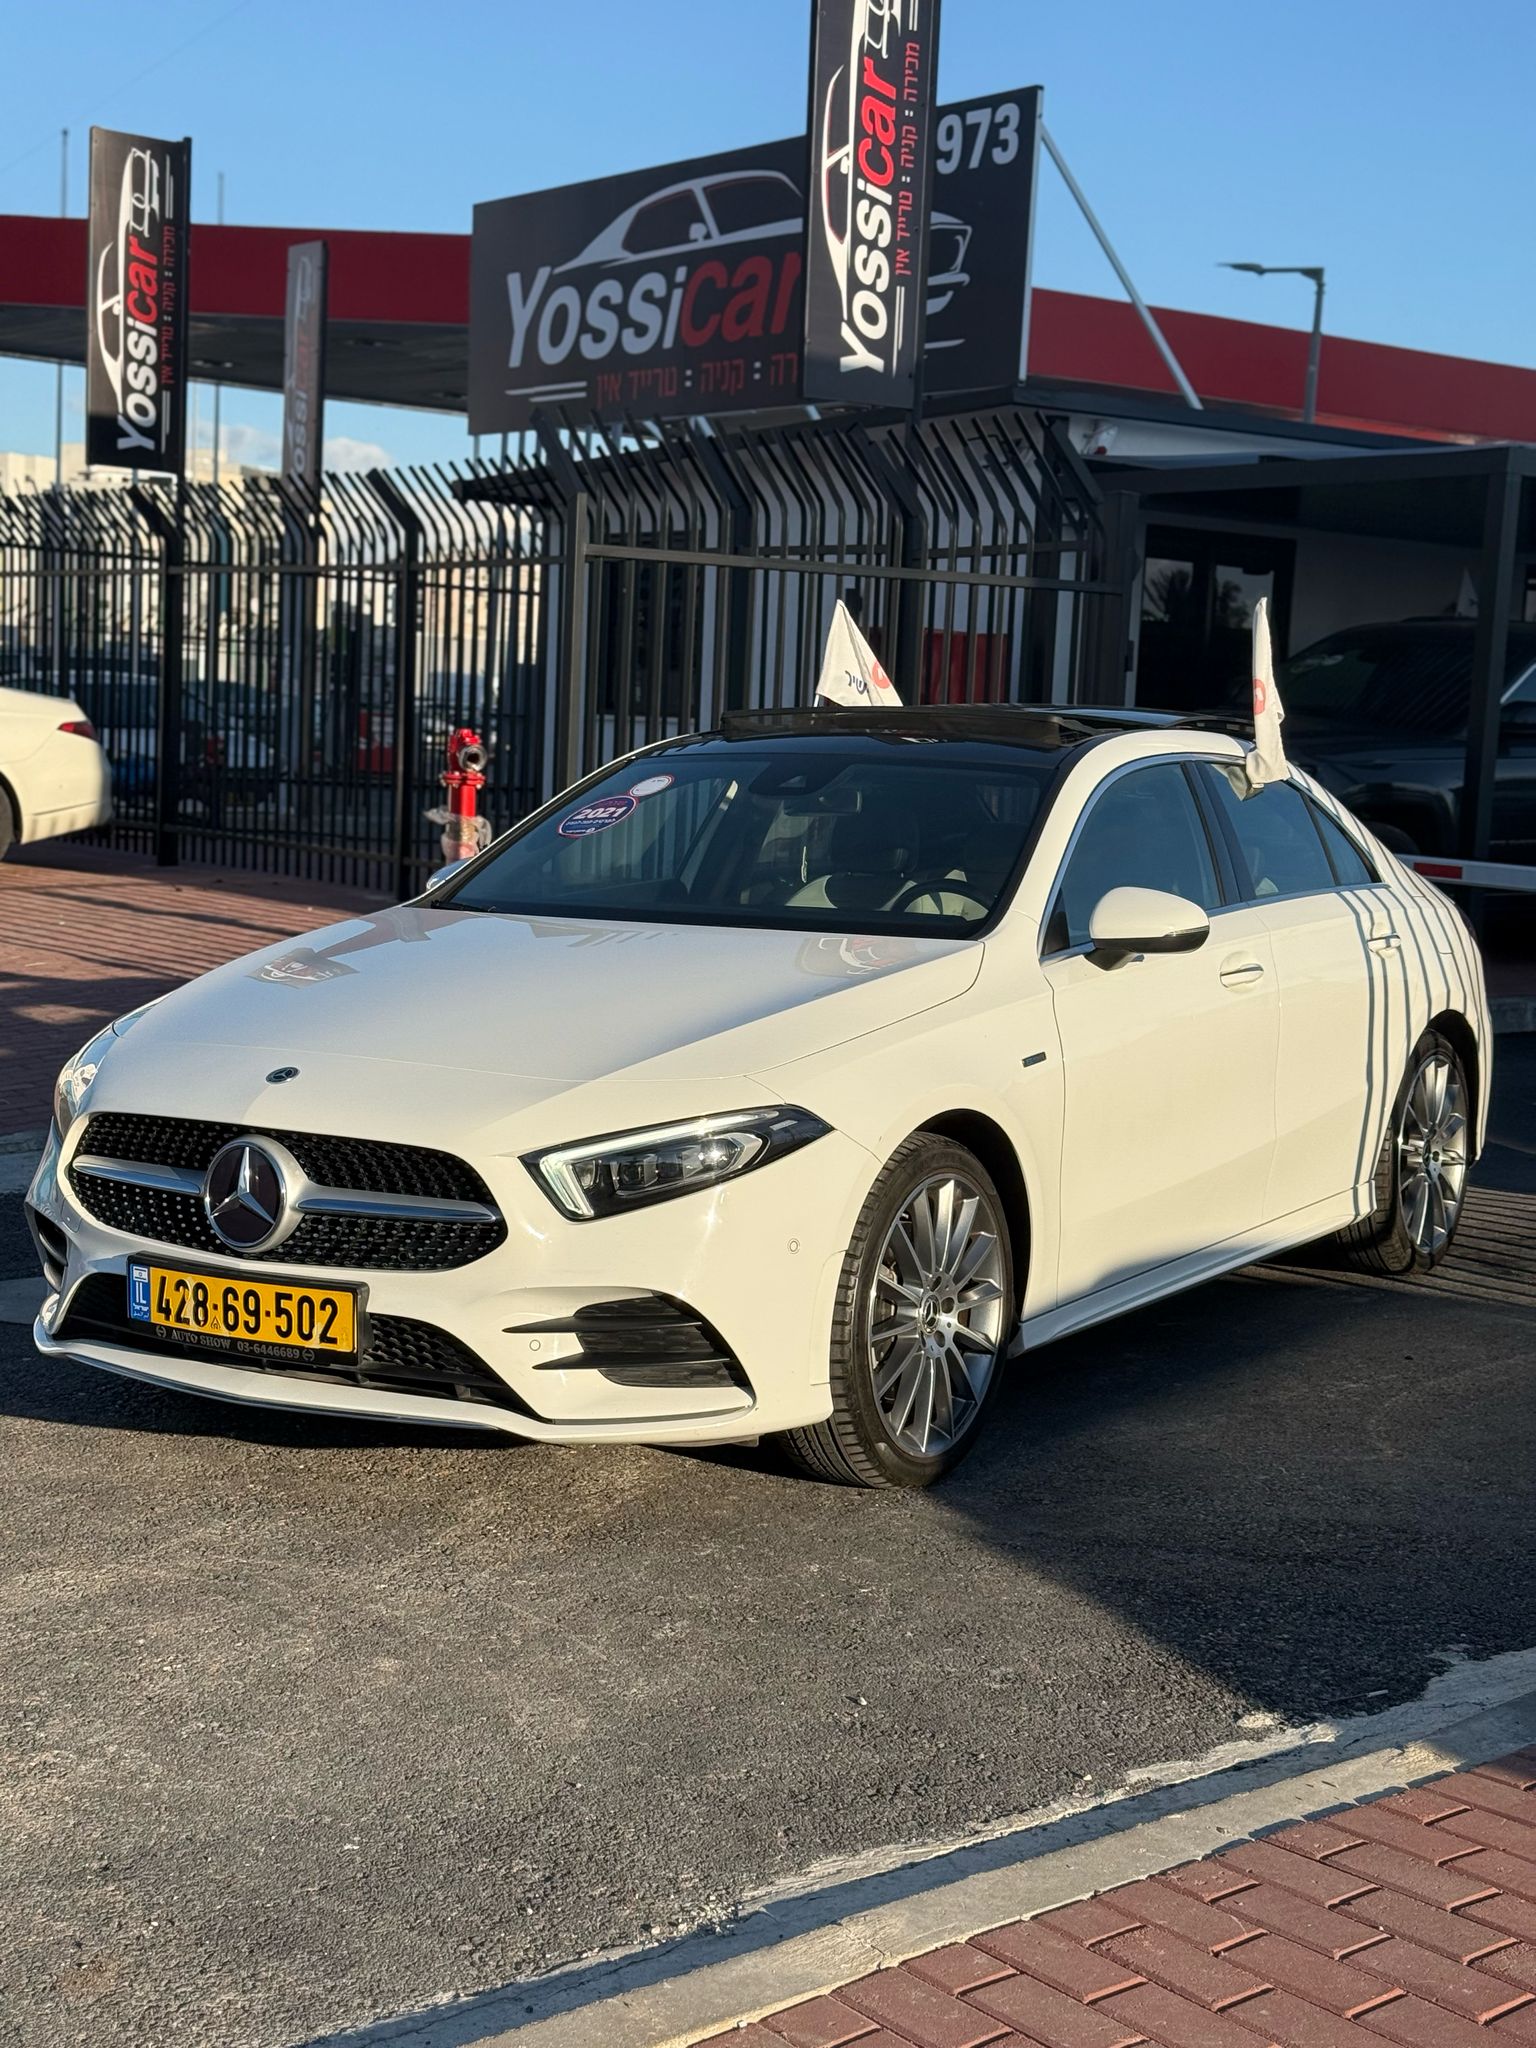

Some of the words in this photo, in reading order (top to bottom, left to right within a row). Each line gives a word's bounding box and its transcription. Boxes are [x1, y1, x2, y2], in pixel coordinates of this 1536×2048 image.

[904, 42, 920, 103] מכירה
[901, 124, 918, 169] קניה
[936, 102, 1020, 176] 973
[896, 190, 913, 241] טרייד
[895, 248, 912, 276] אין
[700, 358, 746, 397] קניה
[572, 806, 629, 820] 2021
[135, 1281, 147, 1304] IL
[170, 1328, 199, 1345] AUTO
[200, 1334, 232, 1350] SHOW
[236, 1340, 301, 1360] 03-6446689
